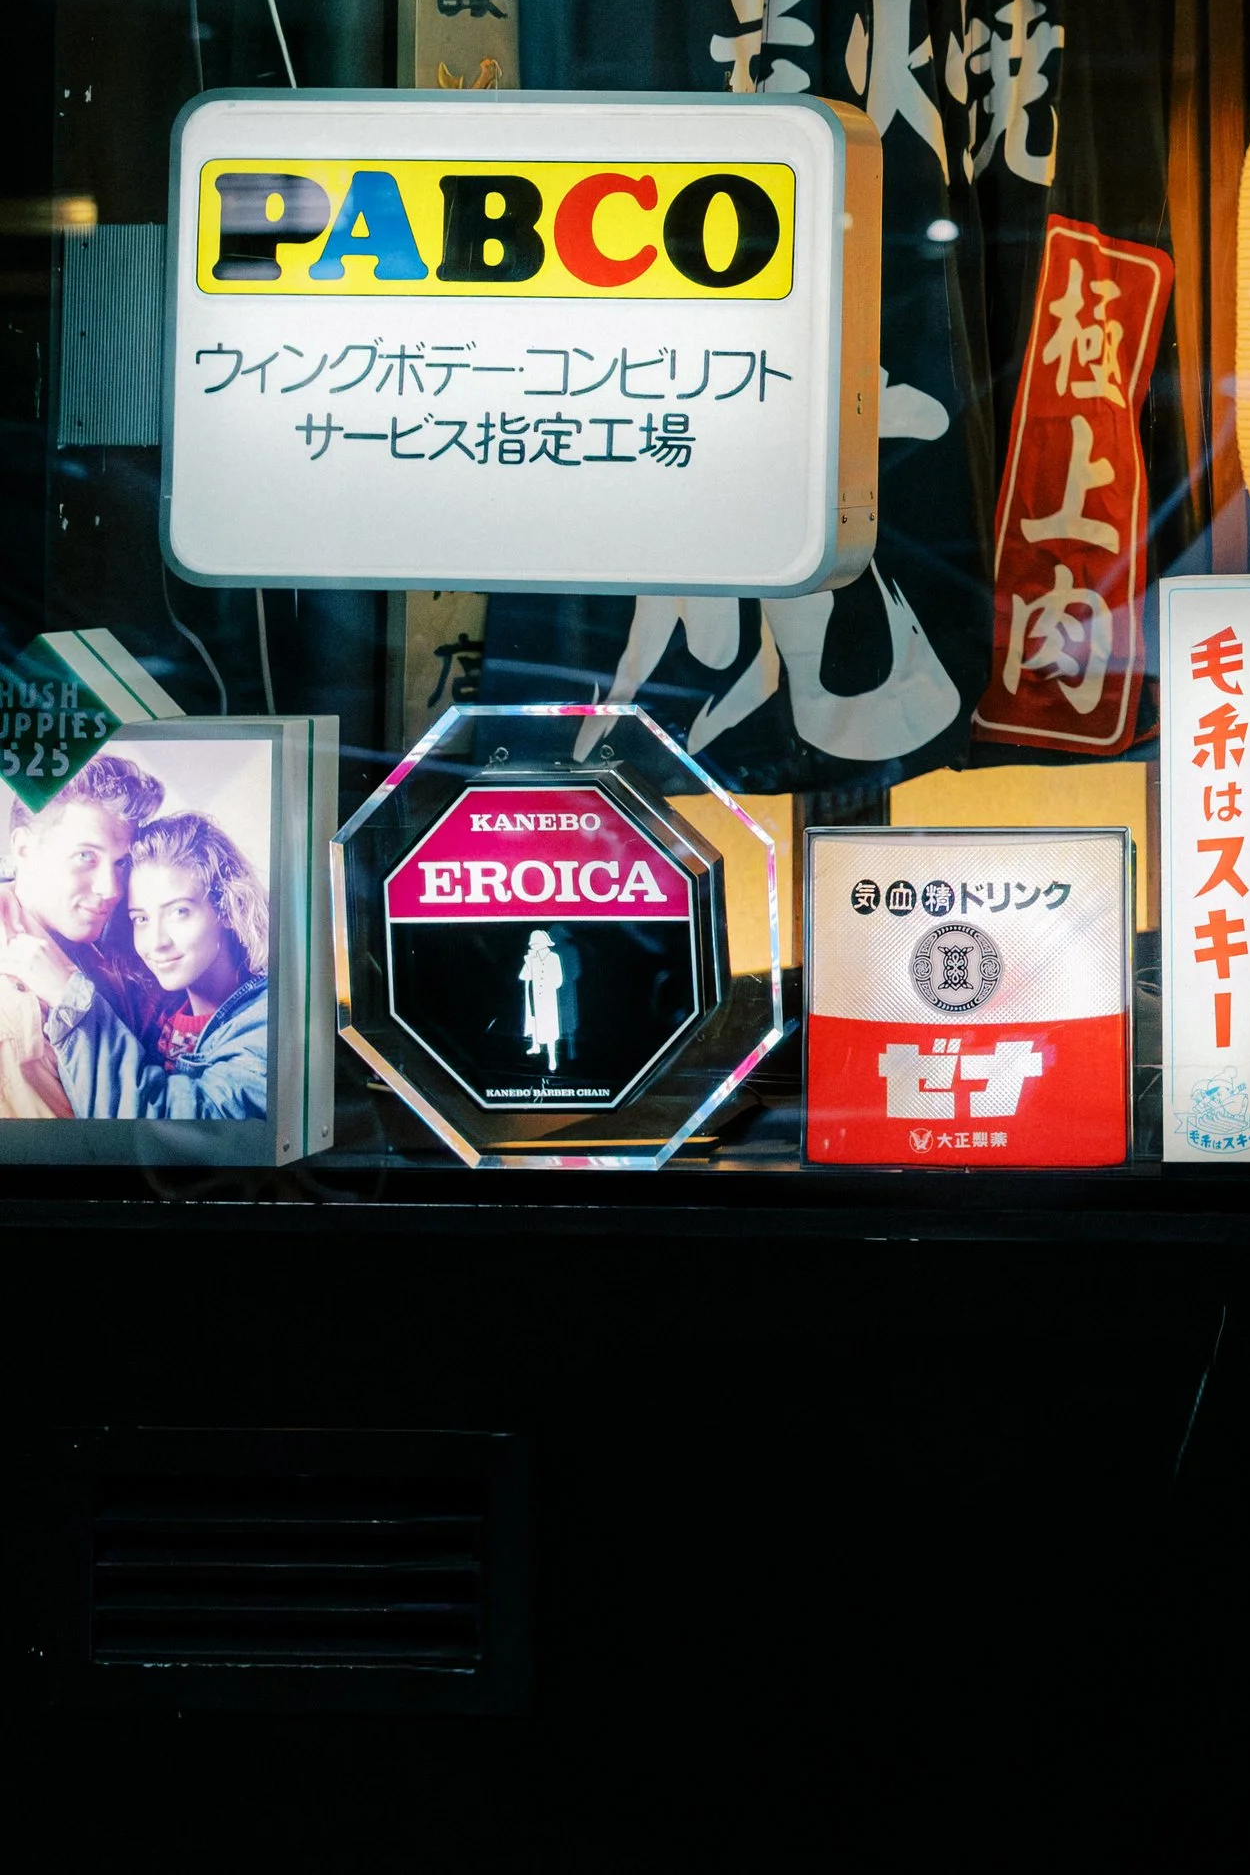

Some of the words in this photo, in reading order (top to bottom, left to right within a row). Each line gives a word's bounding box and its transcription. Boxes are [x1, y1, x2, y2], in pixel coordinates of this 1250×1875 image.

[211, 170, 781, 288] PABCO
[195, 339, 794, 404] ウィングボデー・コンビリフト
[294, 411, 697, 469] サービス指定工場
[1003, 258, 1131, 716] 極上肉
[0, 682, 79, 709] HUSH
[2, 741, 70, 778] 525
[469, 812, 602, 833] KANEBO
[1189, 625, 1250, 1049] 毛糸はスキー
[418, 860, 668, 904] EROICA
[851, 878, 1072, 917] 気血精ドリンク
[486, 1087, 532, 1098] KANEBO
[576, 1087, 611, 1098] CHAIN
[878, 1038, 1044, 1120] ゼナ
[936, 1130, 1009, 1150] 大正製薬
